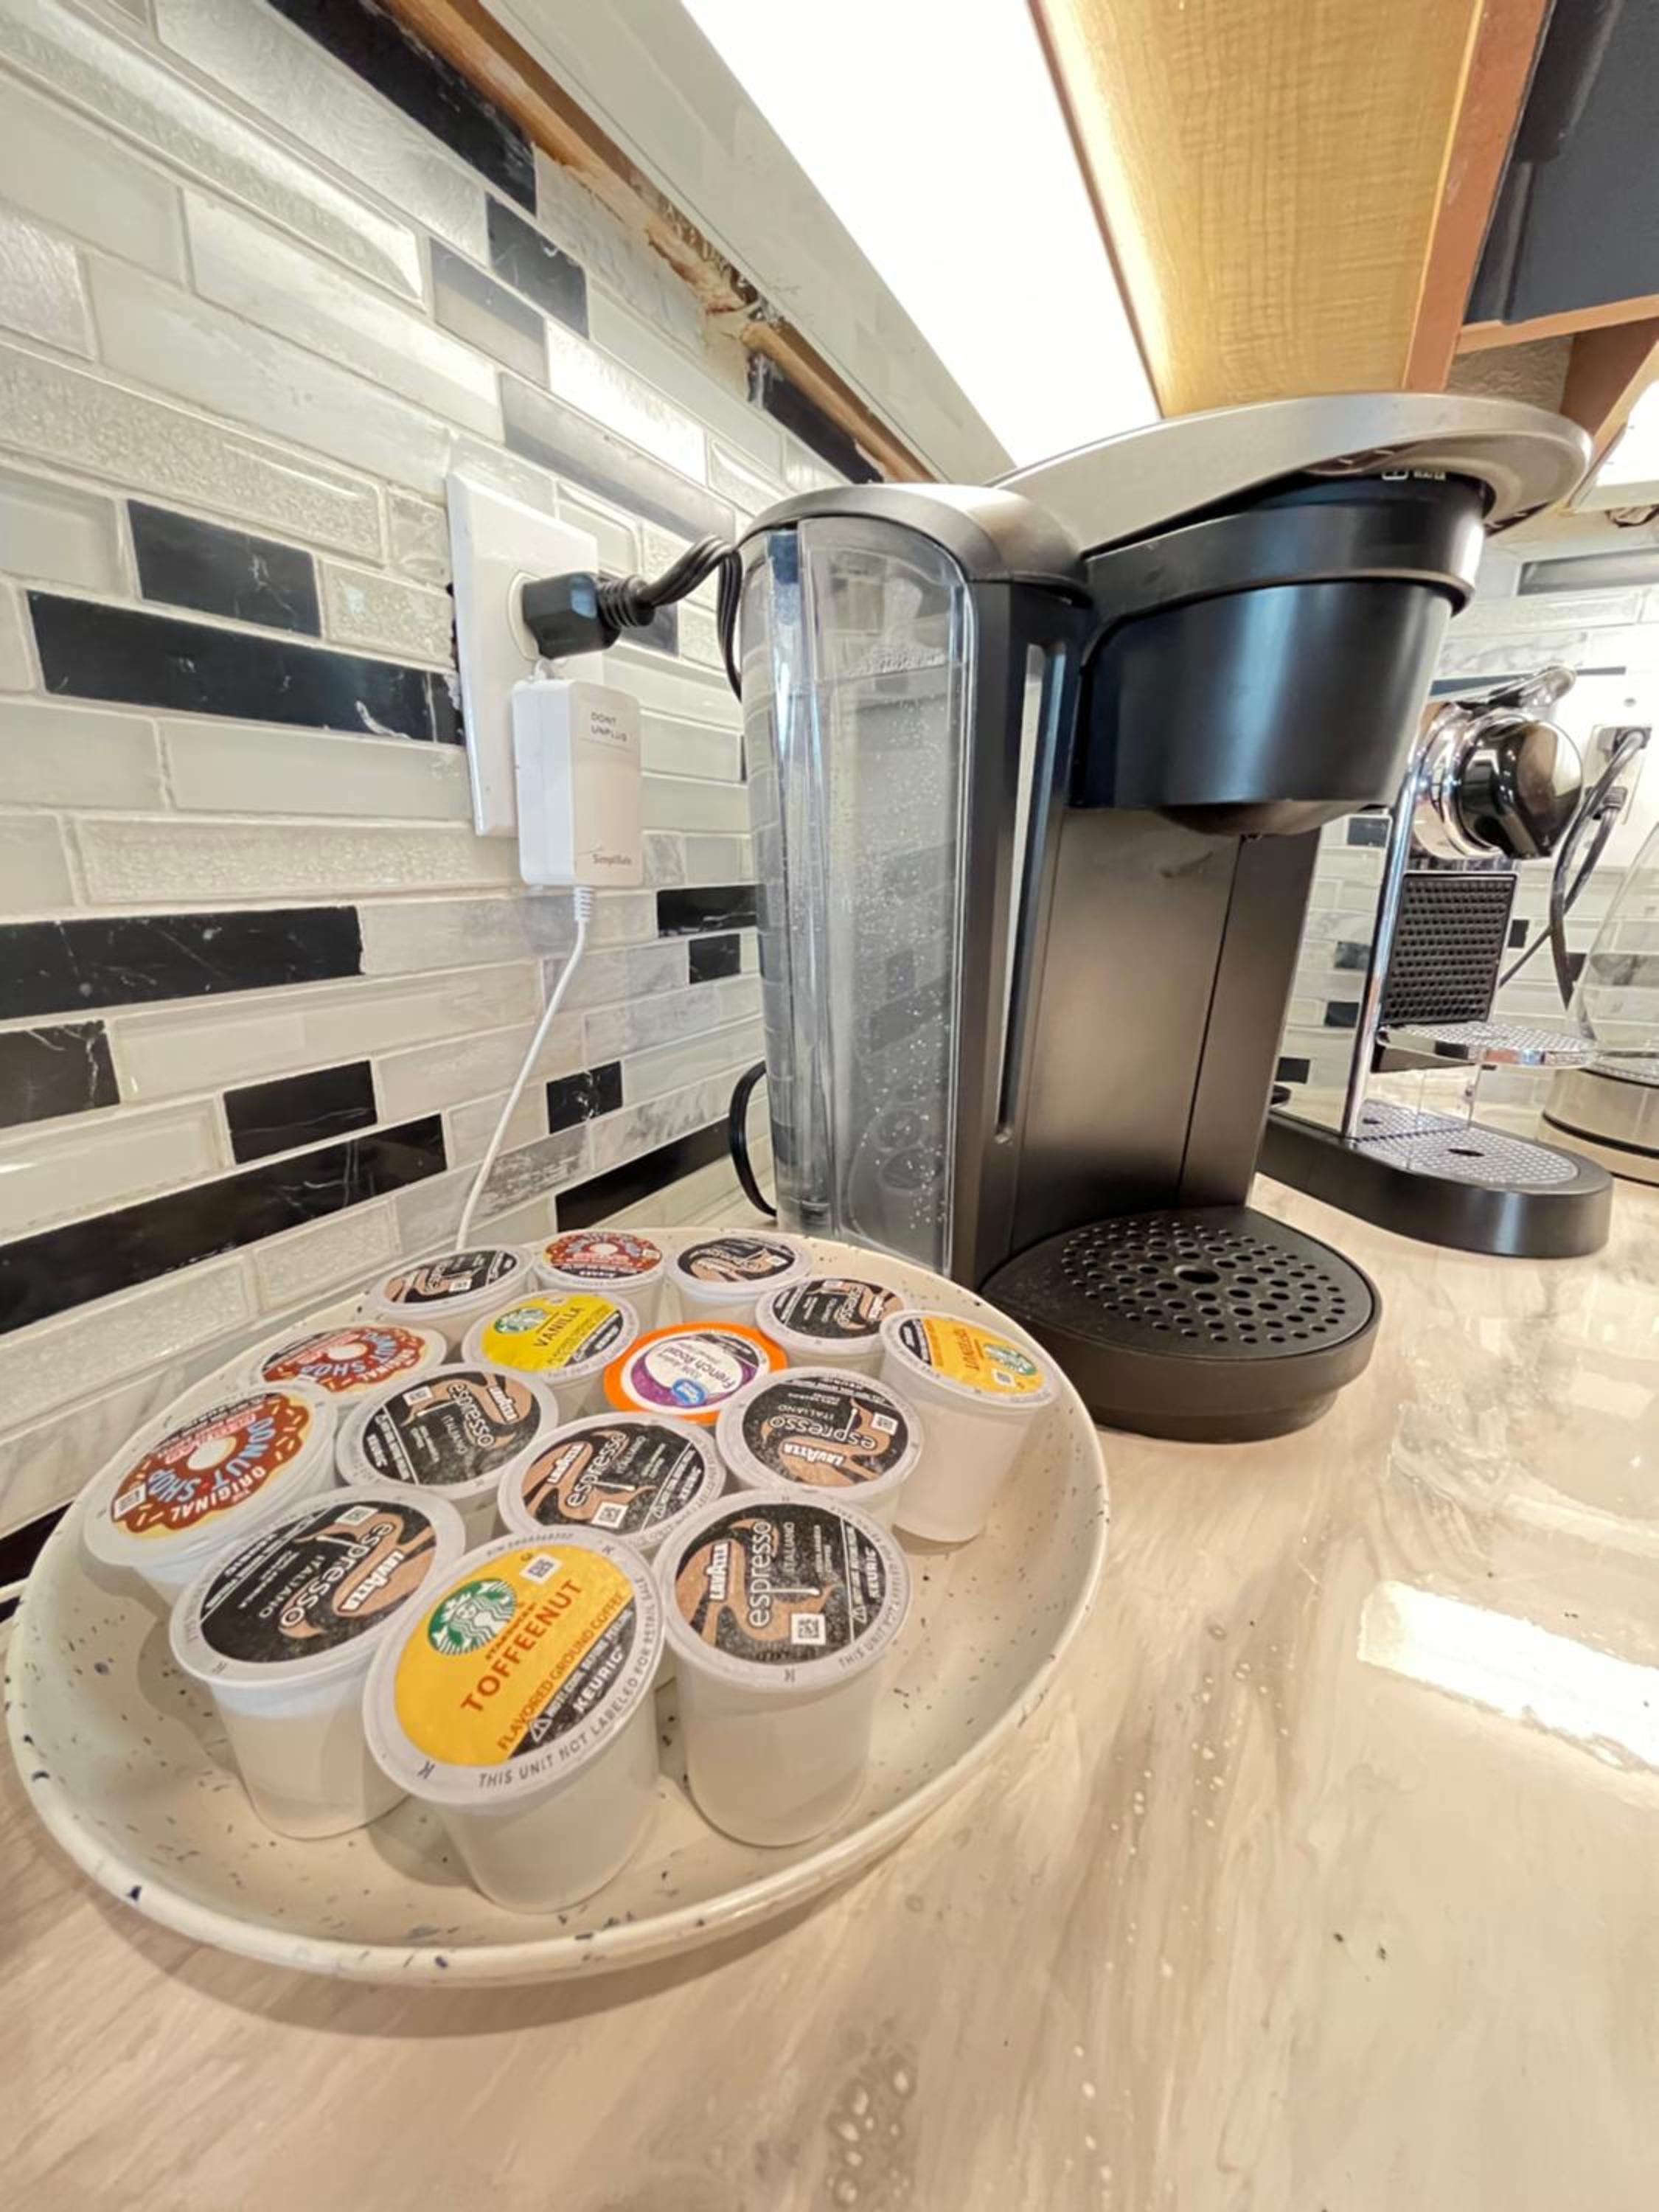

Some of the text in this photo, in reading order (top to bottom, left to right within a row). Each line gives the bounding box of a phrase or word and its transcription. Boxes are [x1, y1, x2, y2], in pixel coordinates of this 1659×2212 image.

[534, 1307, 585, 1347] VANILLA
[448, 1382, 495, 1447] espresso
[769, 1416, 877, 1450] espresso
[778, 1404, 835, 1421] ITALIANO
[212, 1416, 276, 1487] DONUT
[567, 1433, 627, 1508] espresso
[147, 1468, 201, 1502] SHOP
[170, 1466, 266, 1522] ORIGINAL
[281, 1521, 395, 1628] espresso
[749, 1521, 771, 1627] espresso
[783, 1521, 795, 1573] ITALIANO
[865, 1546, 881, 1599] KEURIG
[260, 1554, 325, 1618] ITALIANO
[460, 1579, 582, 1714] TOFFEENUT
[497, 1593, 624, 1750] FLAVORED GROUND COFFEE
[573, 1646, 625, 1714] KEURIG
[479, 1772, 512, 1787] THIS
[518, 1756, 554, 1779] UNIT
[558, 1733, 589, 1761] NOT
[590, 1677, 639, 1735] LABELED
[635, 1649, 650, 1674] FOR
